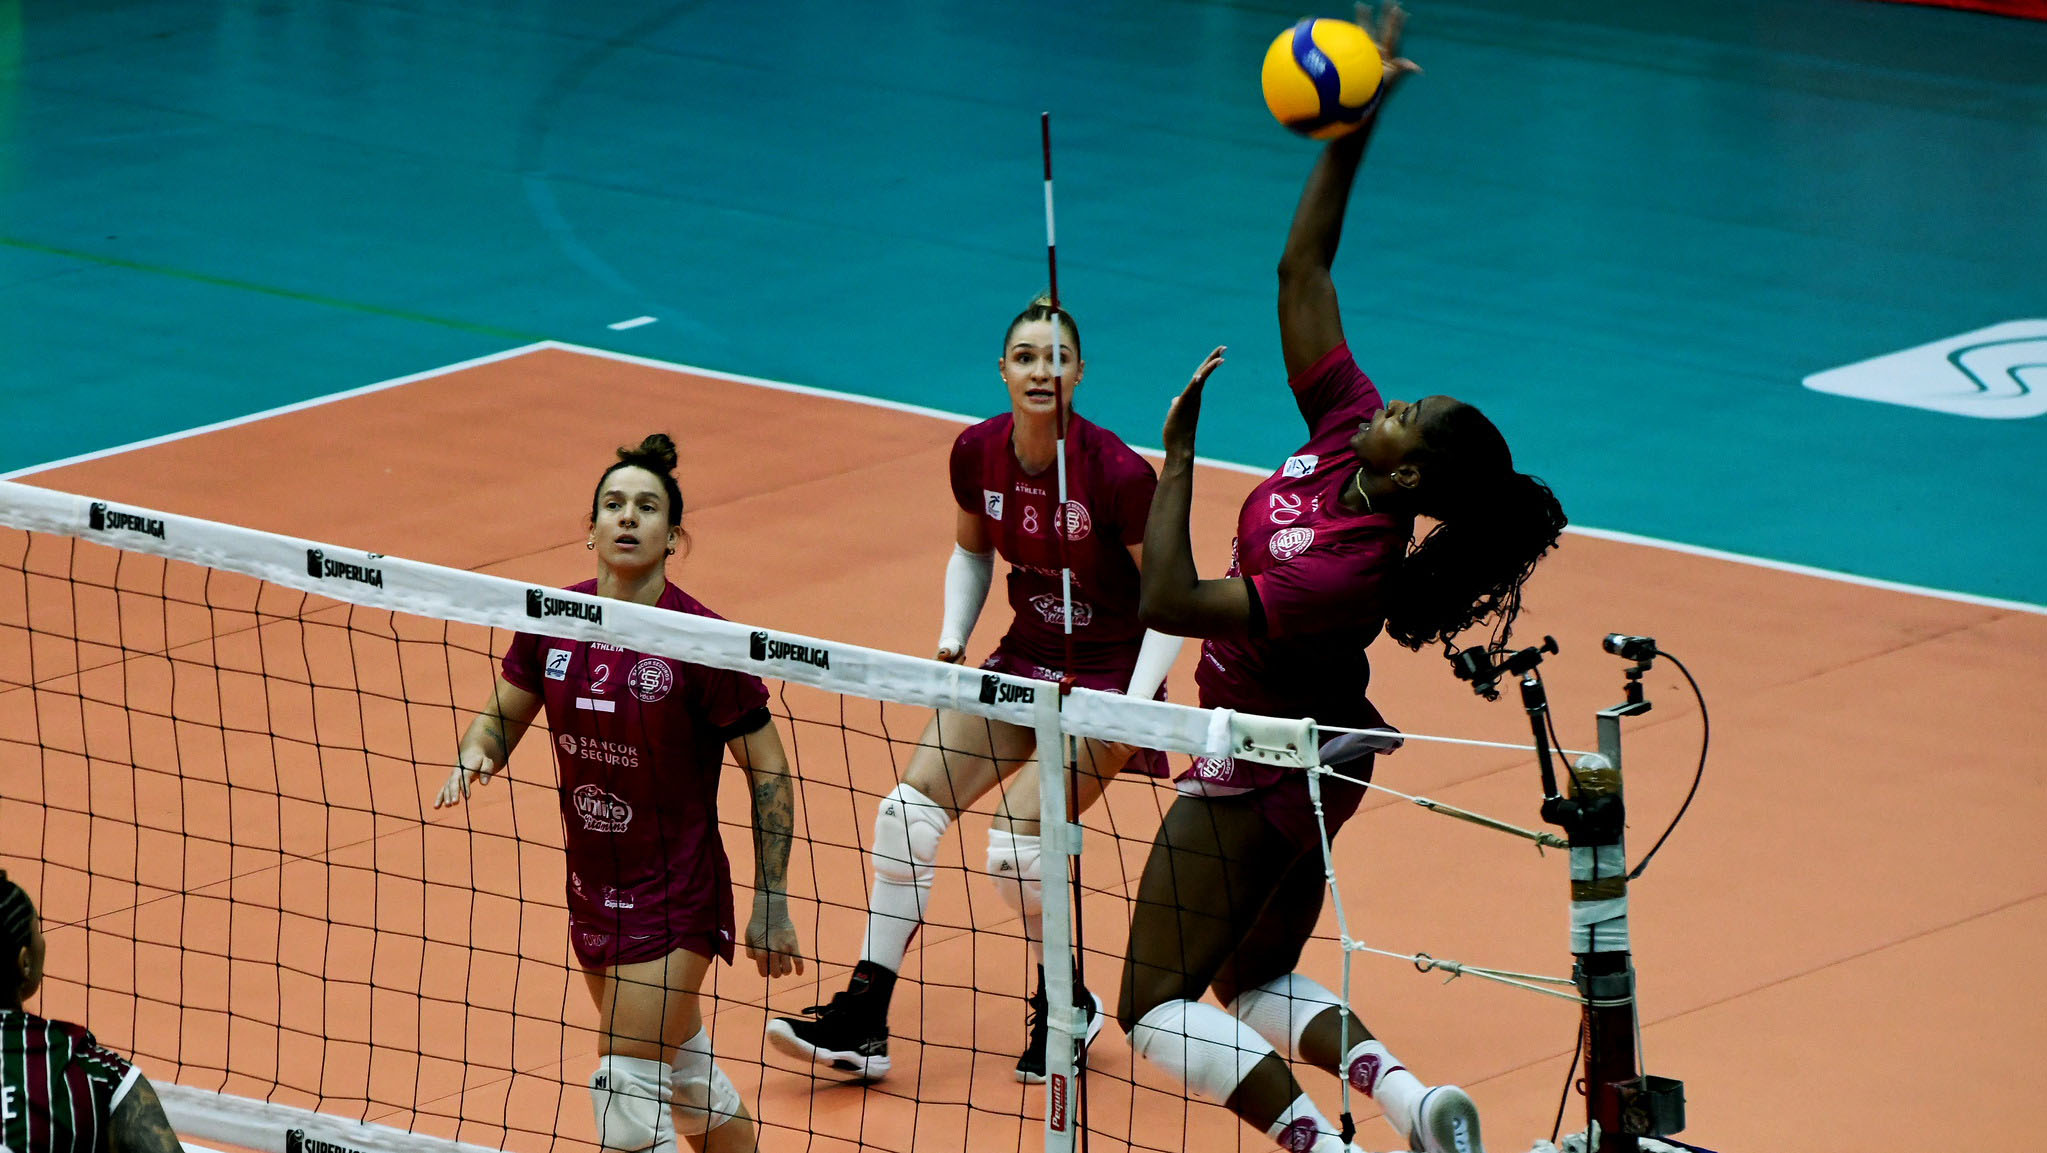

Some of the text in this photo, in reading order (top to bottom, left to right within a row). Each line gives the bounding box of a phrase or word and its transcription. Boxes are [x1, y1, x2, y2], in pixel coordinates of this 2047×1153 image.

[1015, 485, 1046, 496] ATHLETA
[1023, 505, 1038, 534] 8
[1269, 493, 1302, 525] 20
[106, 510, 165, 540] SUPERLIGA
[324, 558, 383, 589] SUPERLIGA
[543, 597, 602, 626] SUPERLIGA
[590, 642, 624, 652] ATHLETA
[768, 639, 830, 671] SUPERLIGA
[590, 663, 609, 694] 2
[580, 736, 637, 756] SANCOR
[580, 749, 639, 768] SEGUROS
[1, 1086, 17, 1119] E
[1052, 1077, 1064, 1128] Pequita
